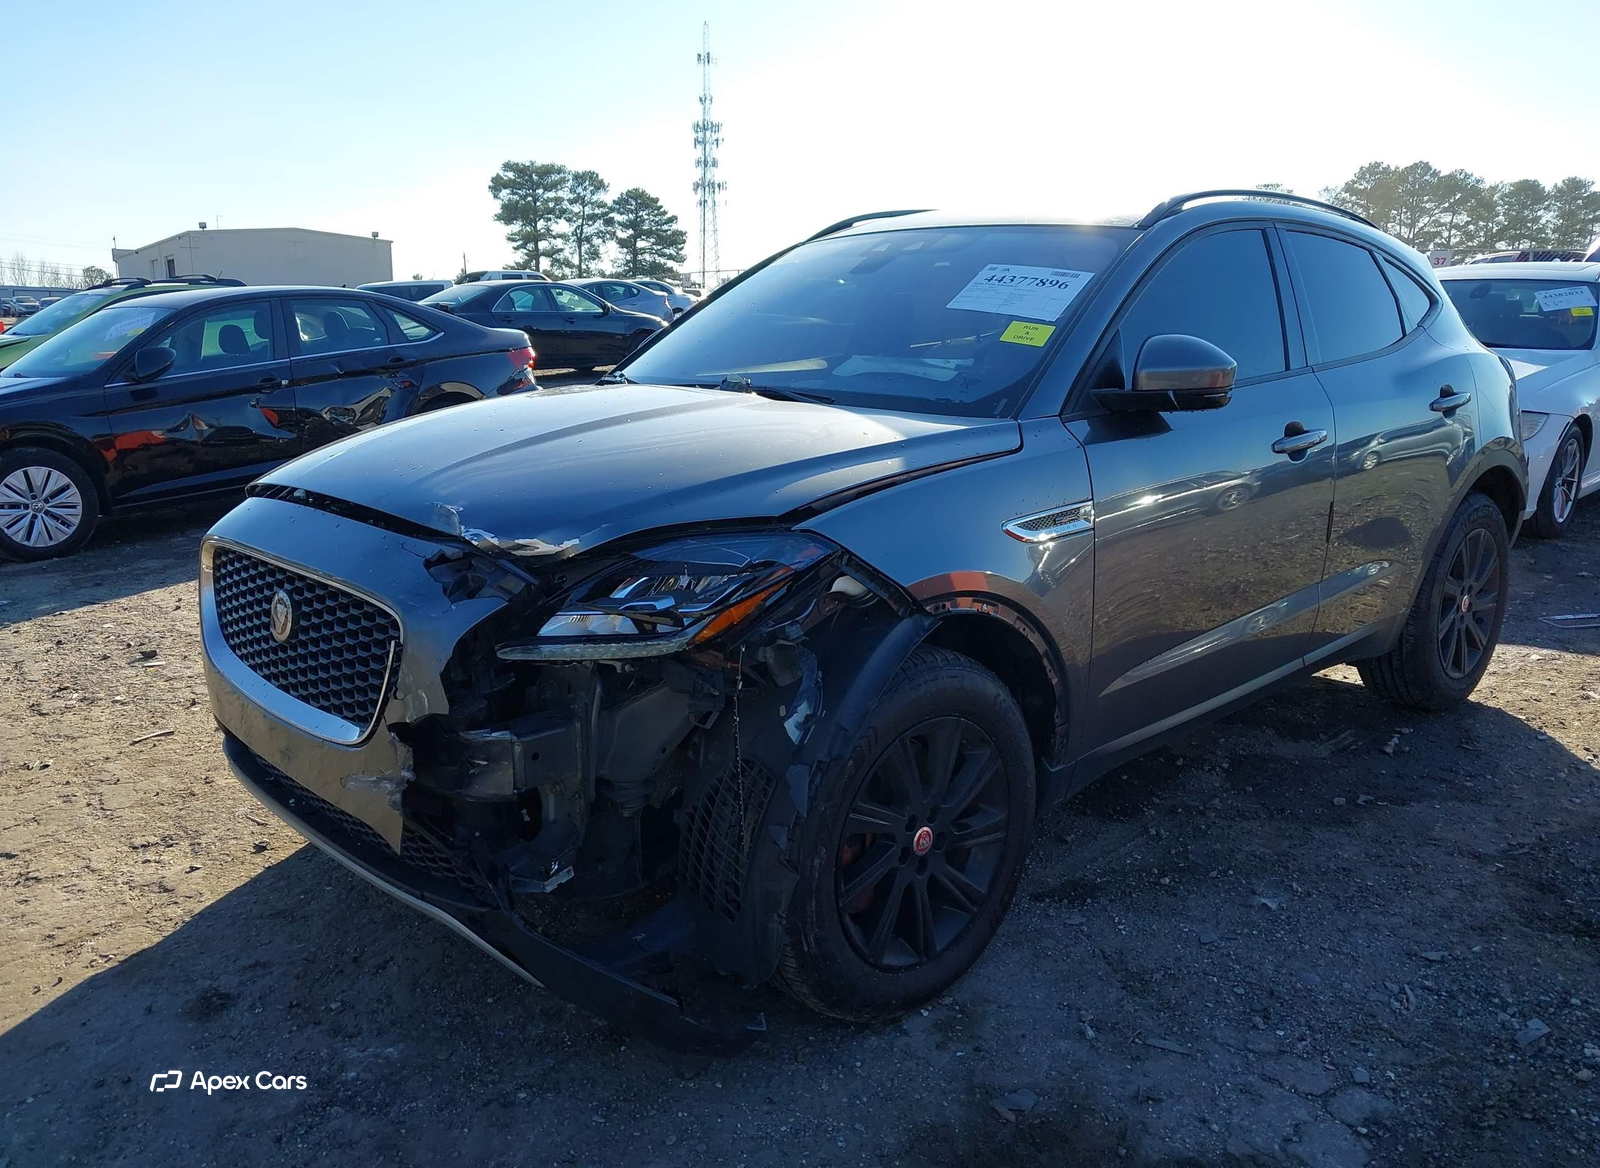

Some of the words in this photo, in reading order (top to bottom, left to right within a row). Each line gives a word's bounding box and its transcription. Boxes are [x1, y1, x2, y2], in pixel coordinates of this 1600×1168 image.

[1433, 257, 1447, 266] 37
[984, 273, 1072, 291] 44377896
[1045, 523, 1077, 535] AGUAR
